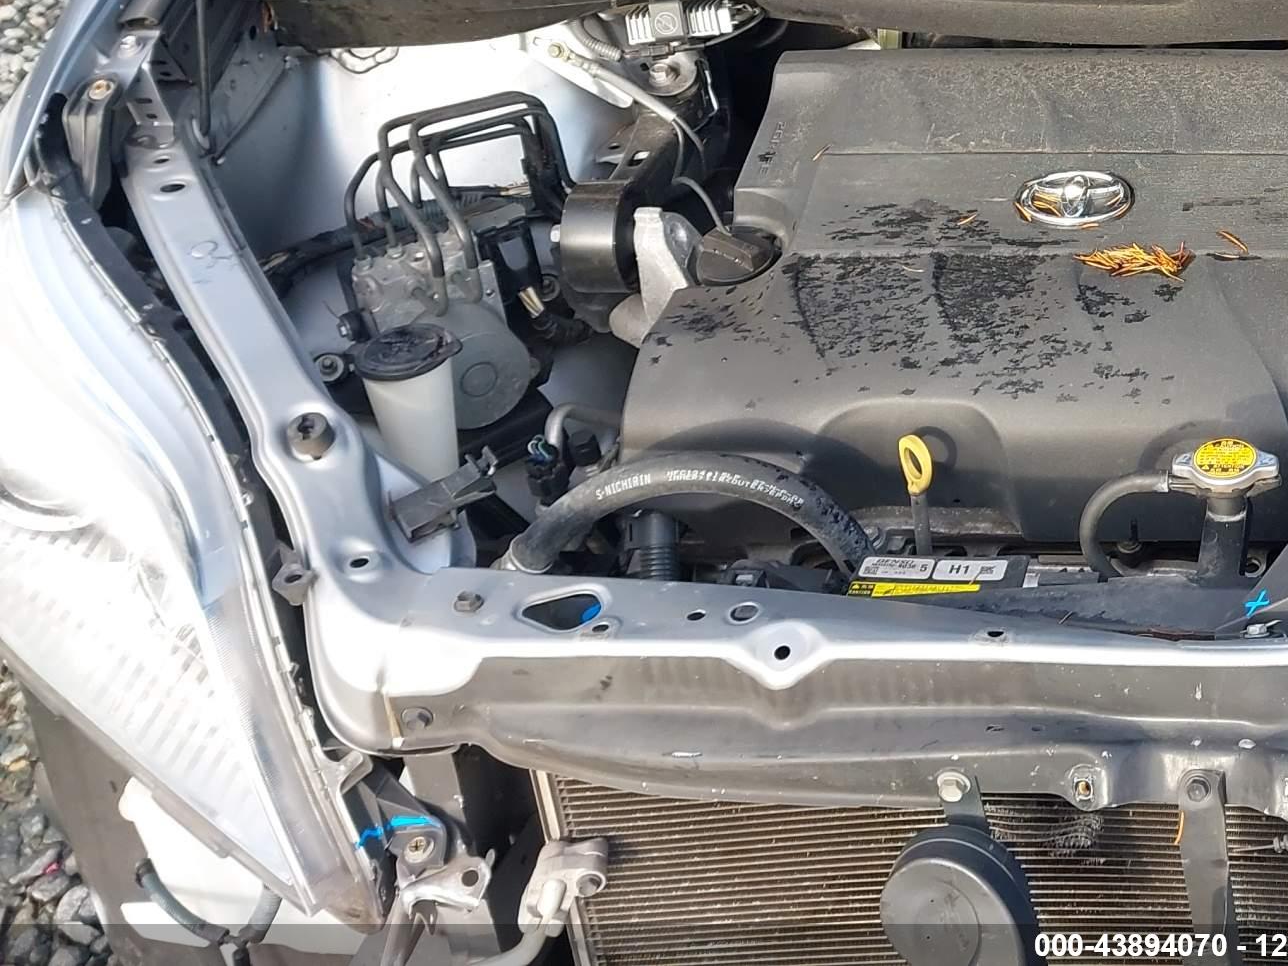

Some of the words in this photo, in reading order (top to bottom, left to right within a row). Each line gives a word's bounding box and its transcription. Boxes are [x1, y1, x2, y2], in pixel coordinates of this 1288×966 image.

[595, 473, 651, 500] S-NICHIRIN
[919, 563, 928, 572] 5
[949, 565, 969, 575] H1
